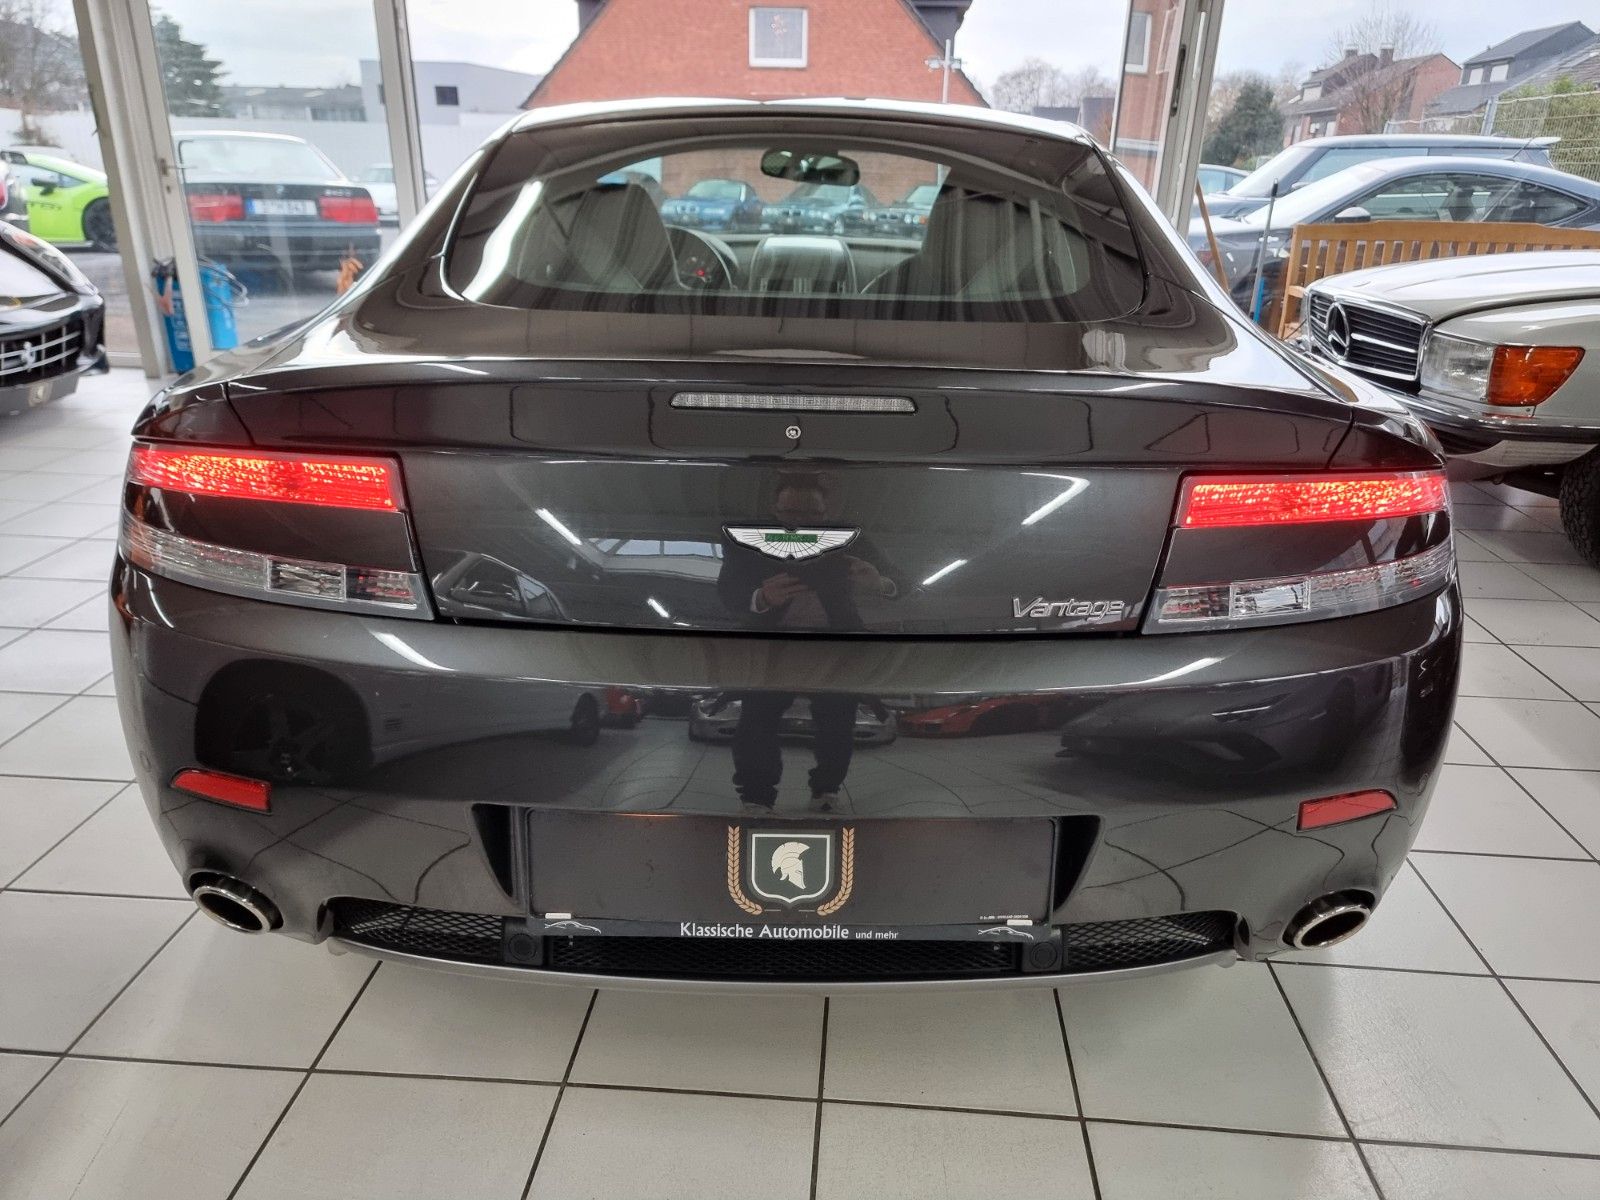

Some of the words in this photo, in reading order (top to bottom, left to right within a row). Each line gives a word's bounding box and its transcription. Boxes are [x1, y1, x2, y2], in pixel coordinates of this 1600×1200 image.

[1012, 597, 1125, 621] Vantage
[680, 922, 753, 937] Klassische
[759, 924, 849, 939] Automobile
[855, 930, 872, 939] und
[875, 930, 899, 939] mehr
